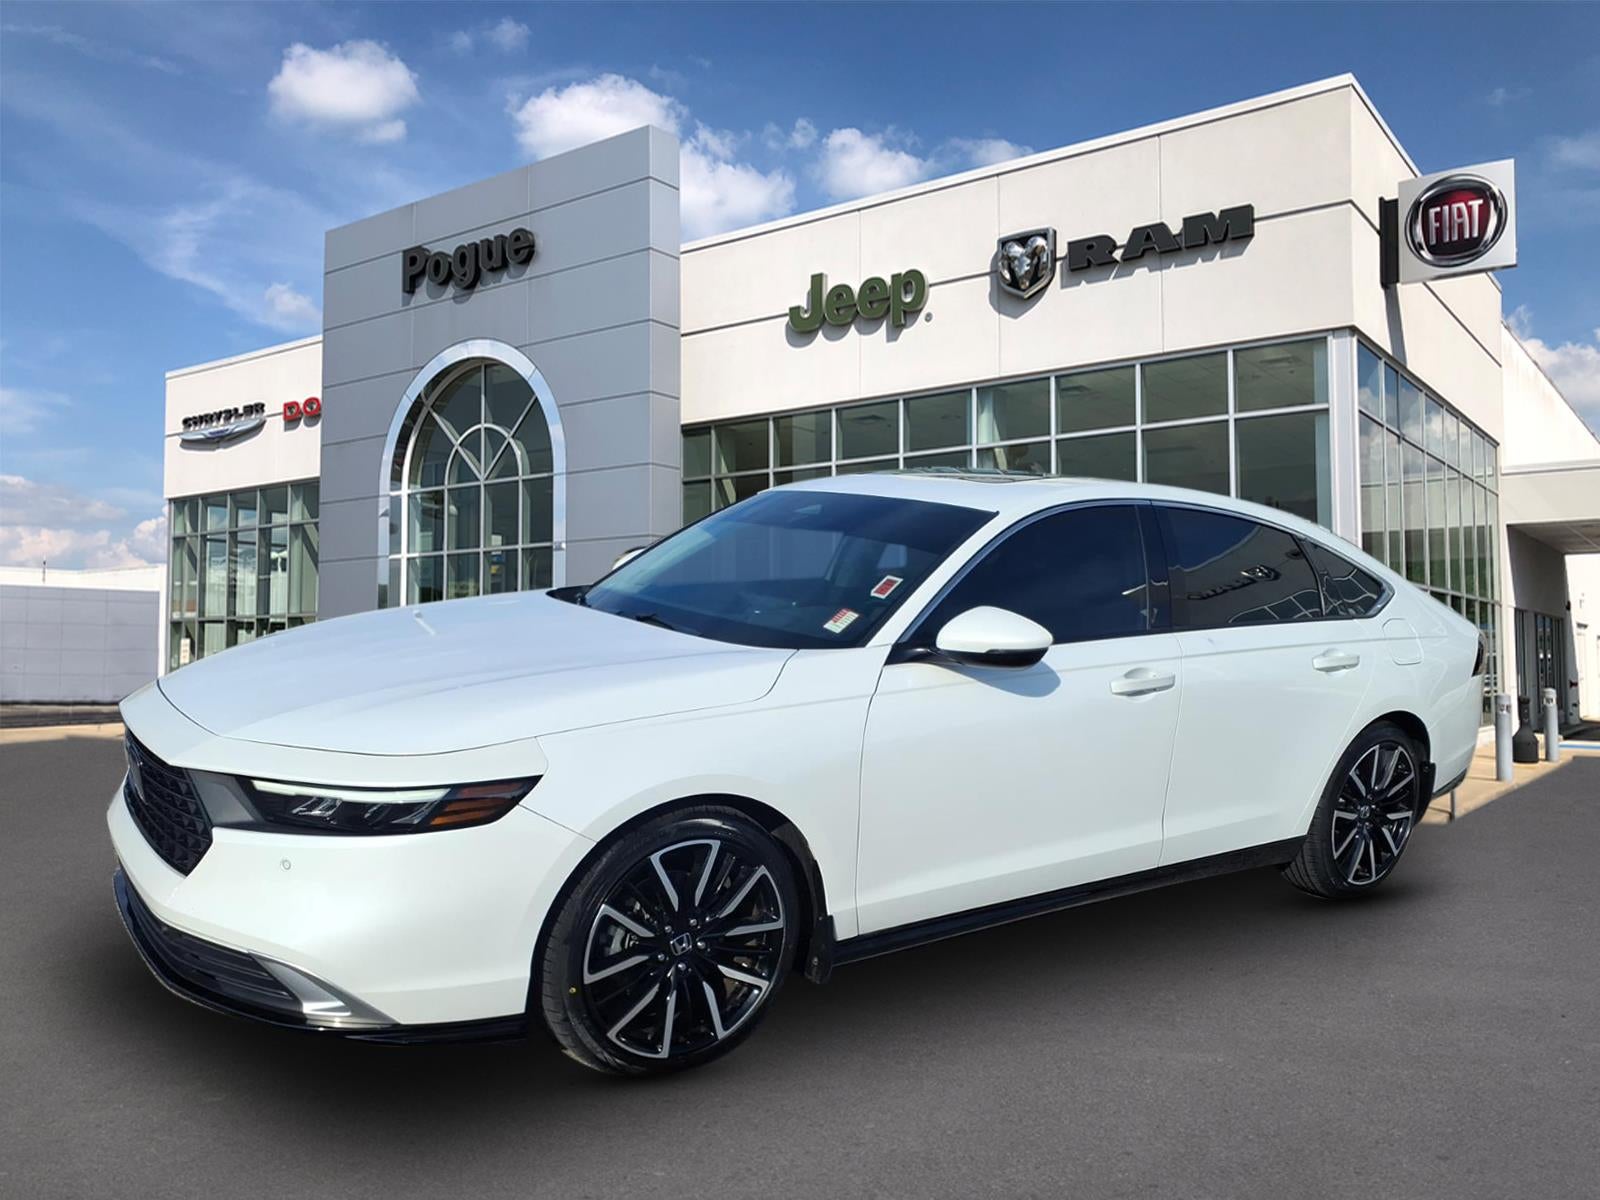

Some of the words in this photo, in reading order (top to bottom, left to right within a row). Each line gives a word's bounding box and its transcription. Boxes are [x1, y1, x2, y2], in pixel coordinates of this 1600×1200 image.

[1066, 203, 1254, 271] RAM
[1428, 199, 1484, 246] FIAT
[402, 227, 535, 294] Pogue
[789, 269, 928, 332] Jeep
